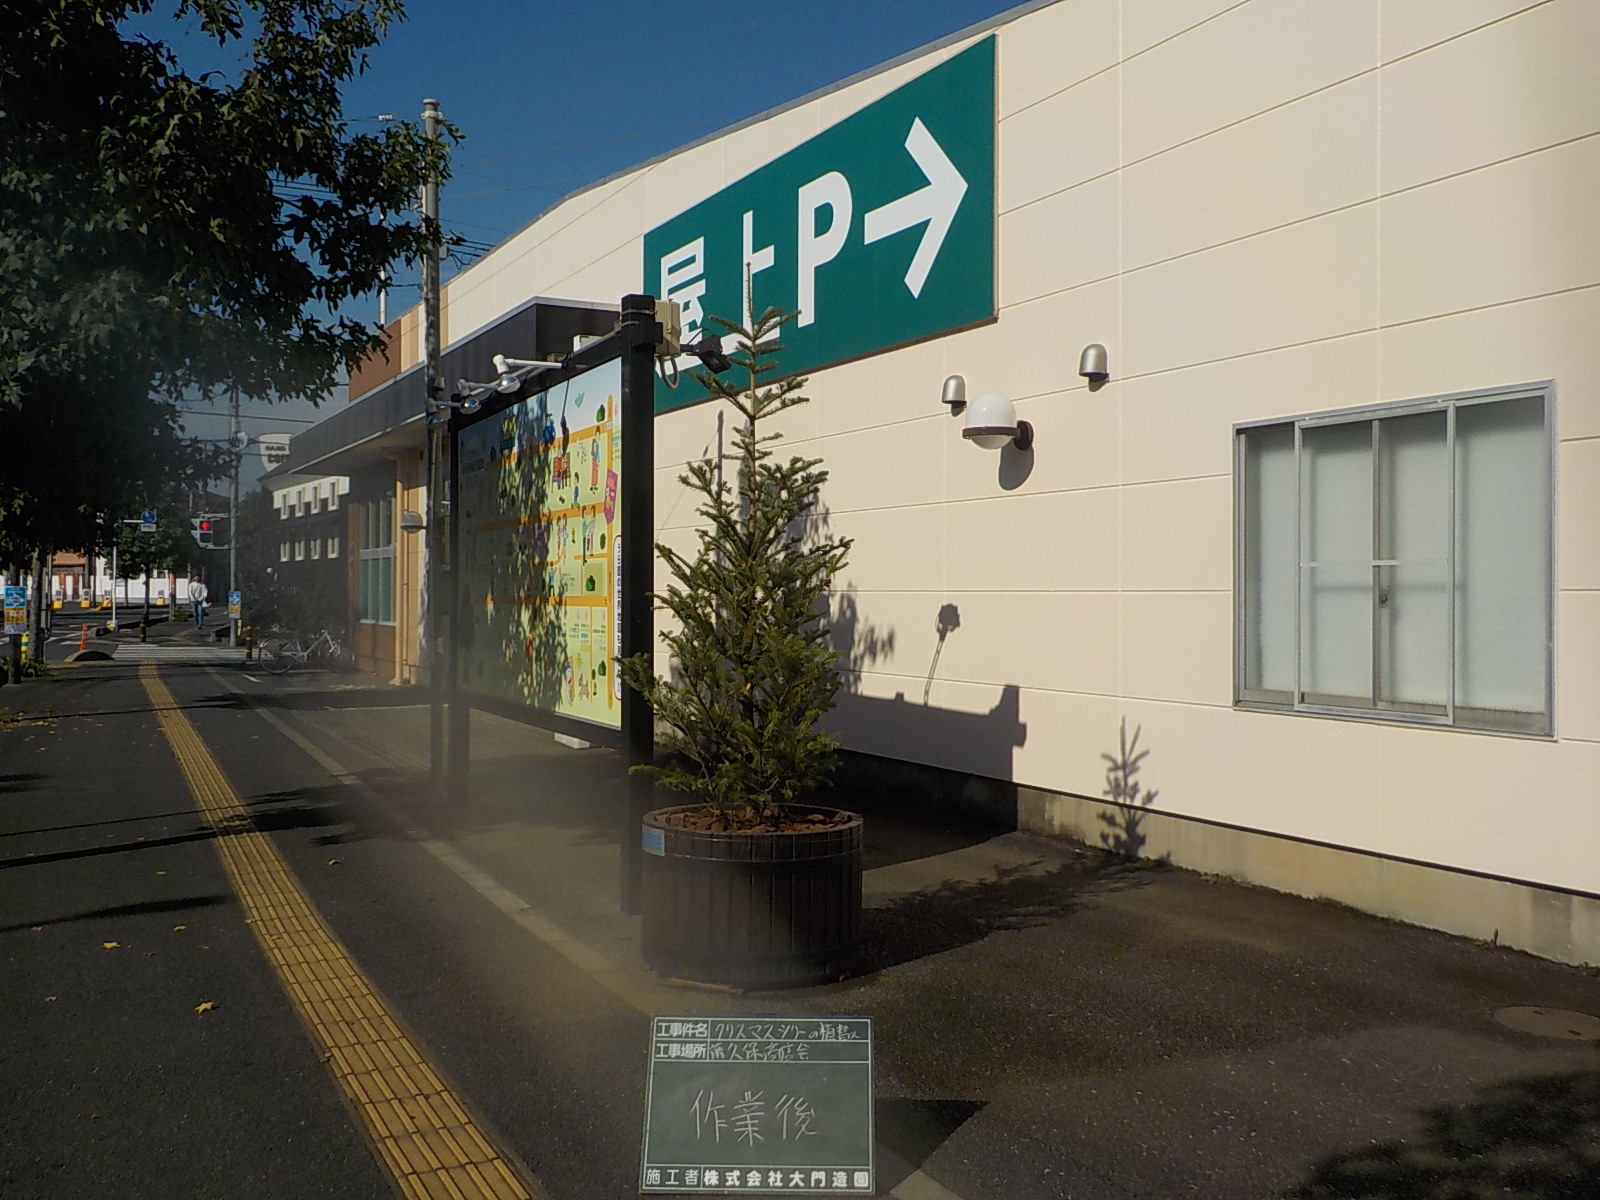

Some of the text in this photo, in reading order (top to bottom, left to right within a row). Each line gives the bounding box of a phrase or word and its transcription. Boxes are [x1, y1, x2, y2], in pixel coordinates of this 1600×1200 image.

[656, 1022, 708, 1038] 工事件名
[655, 1043, 707, 1059] 工事場所
[690, 1089, 817, 1147] 作業後
[646, 1167, 700, 1186] 施工者
[703, 1169, 869, 1188] 株式会社大門造園
